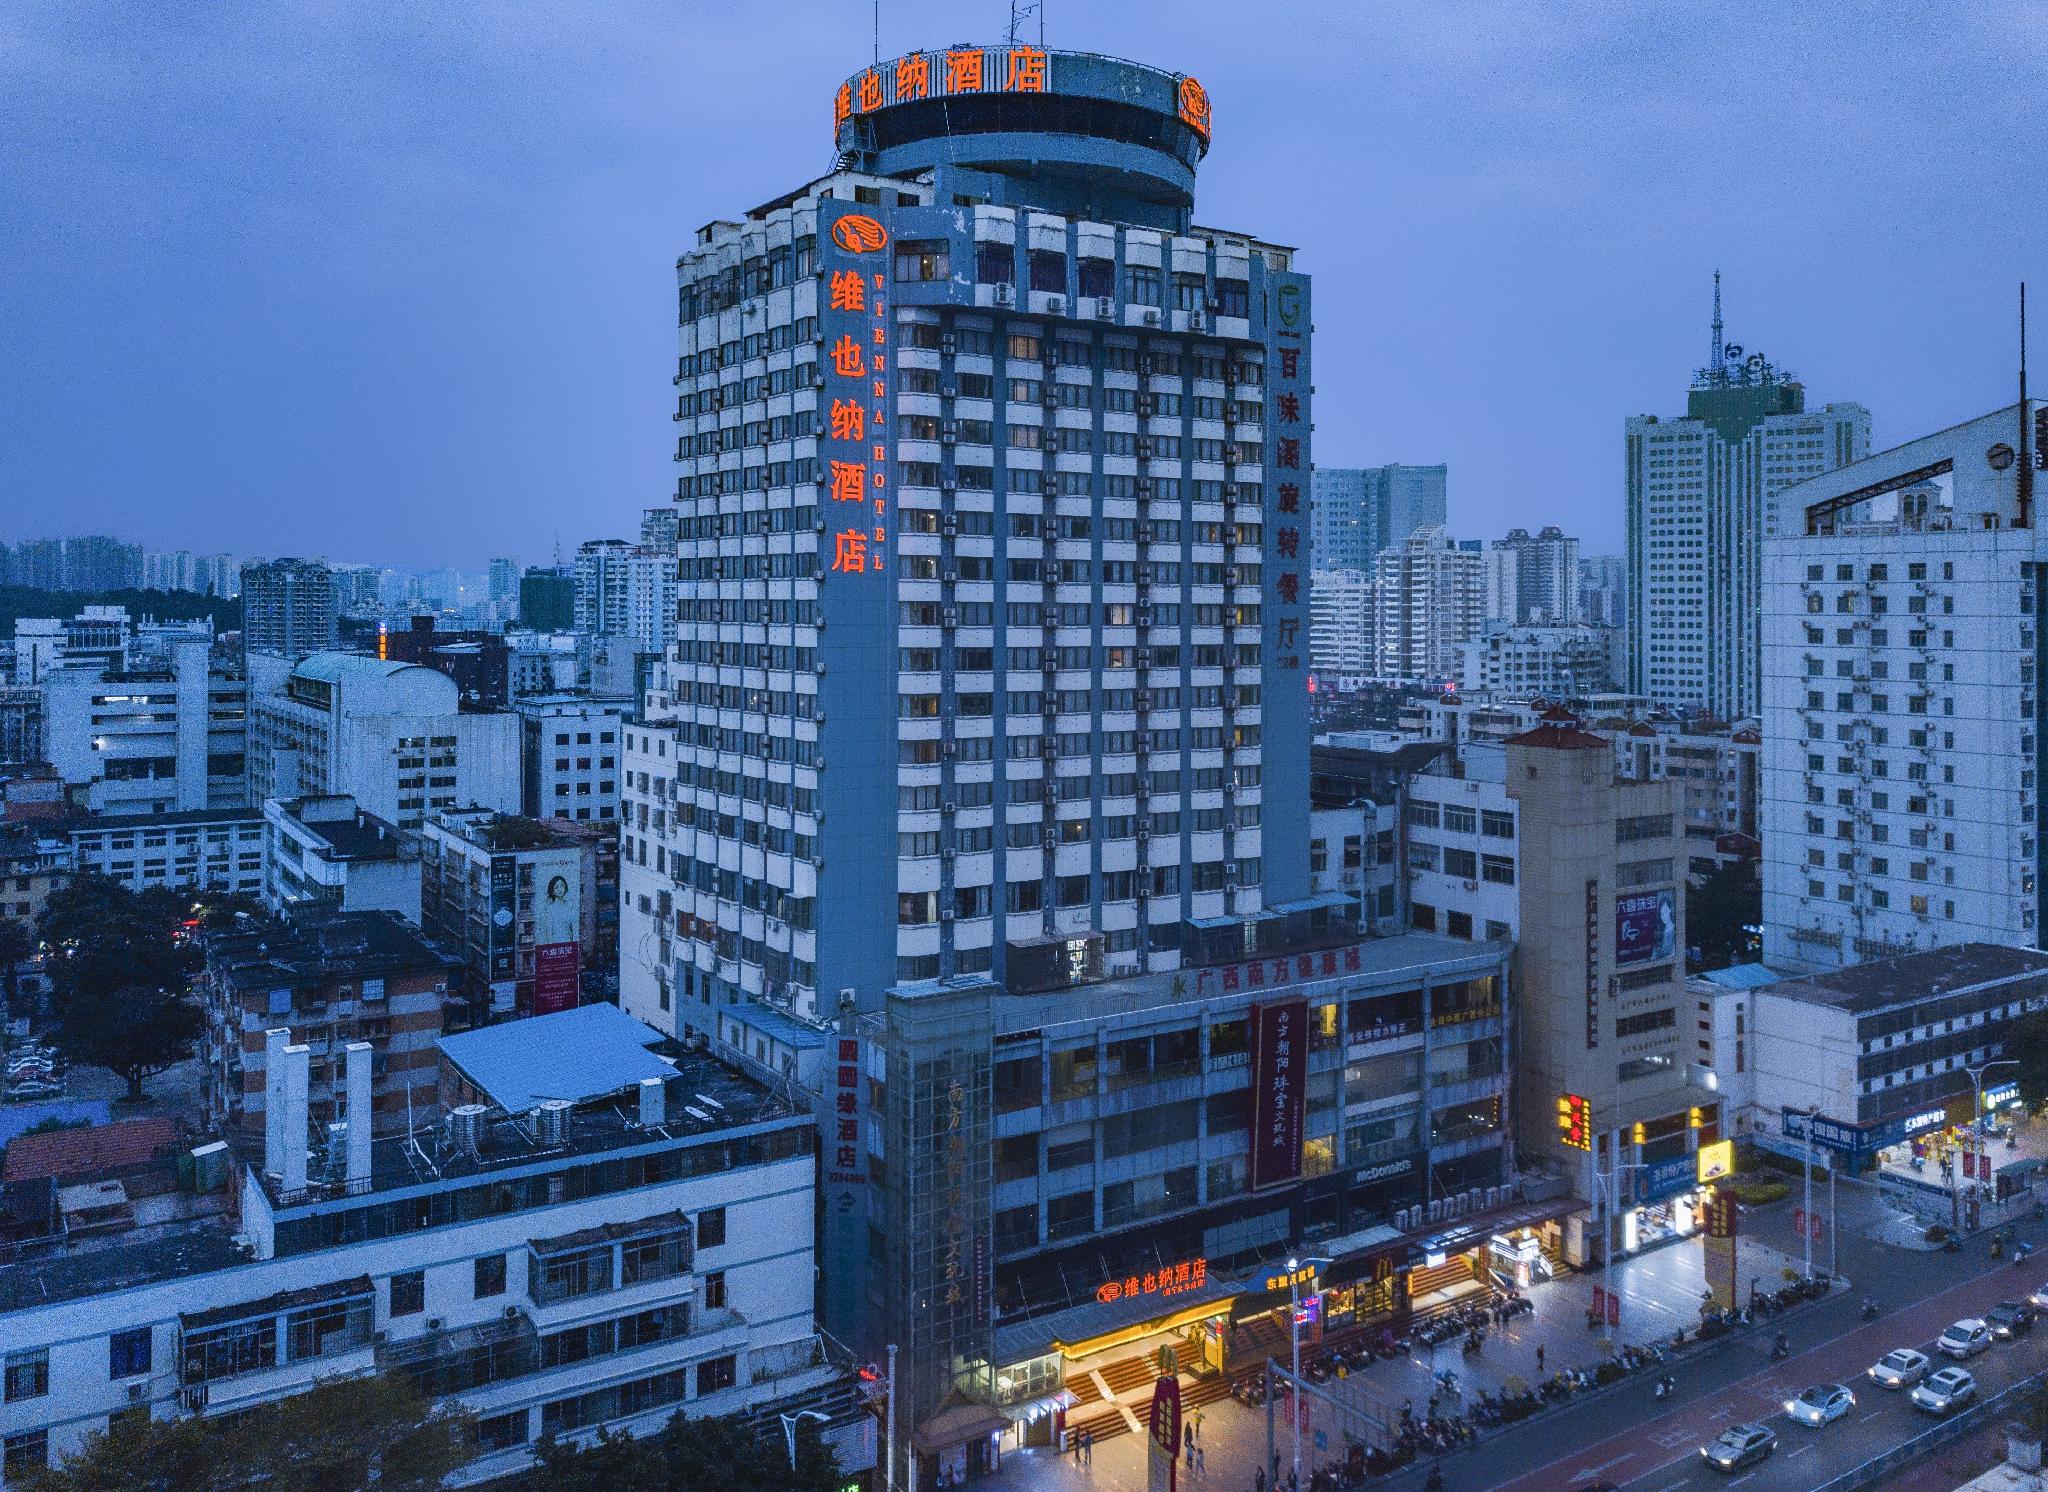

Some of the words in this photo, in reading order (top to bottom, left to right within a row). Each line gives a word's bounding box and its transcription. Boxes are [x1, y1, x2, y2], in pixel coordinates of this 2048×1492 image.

[874, 274, 885, 425] VIENNA
[830, 270, 867, 574] 维也纳酒店
[874, 446, 885, 571] HOTEL
[1124, 1258, 1206, 1298] 维也纳酒店
